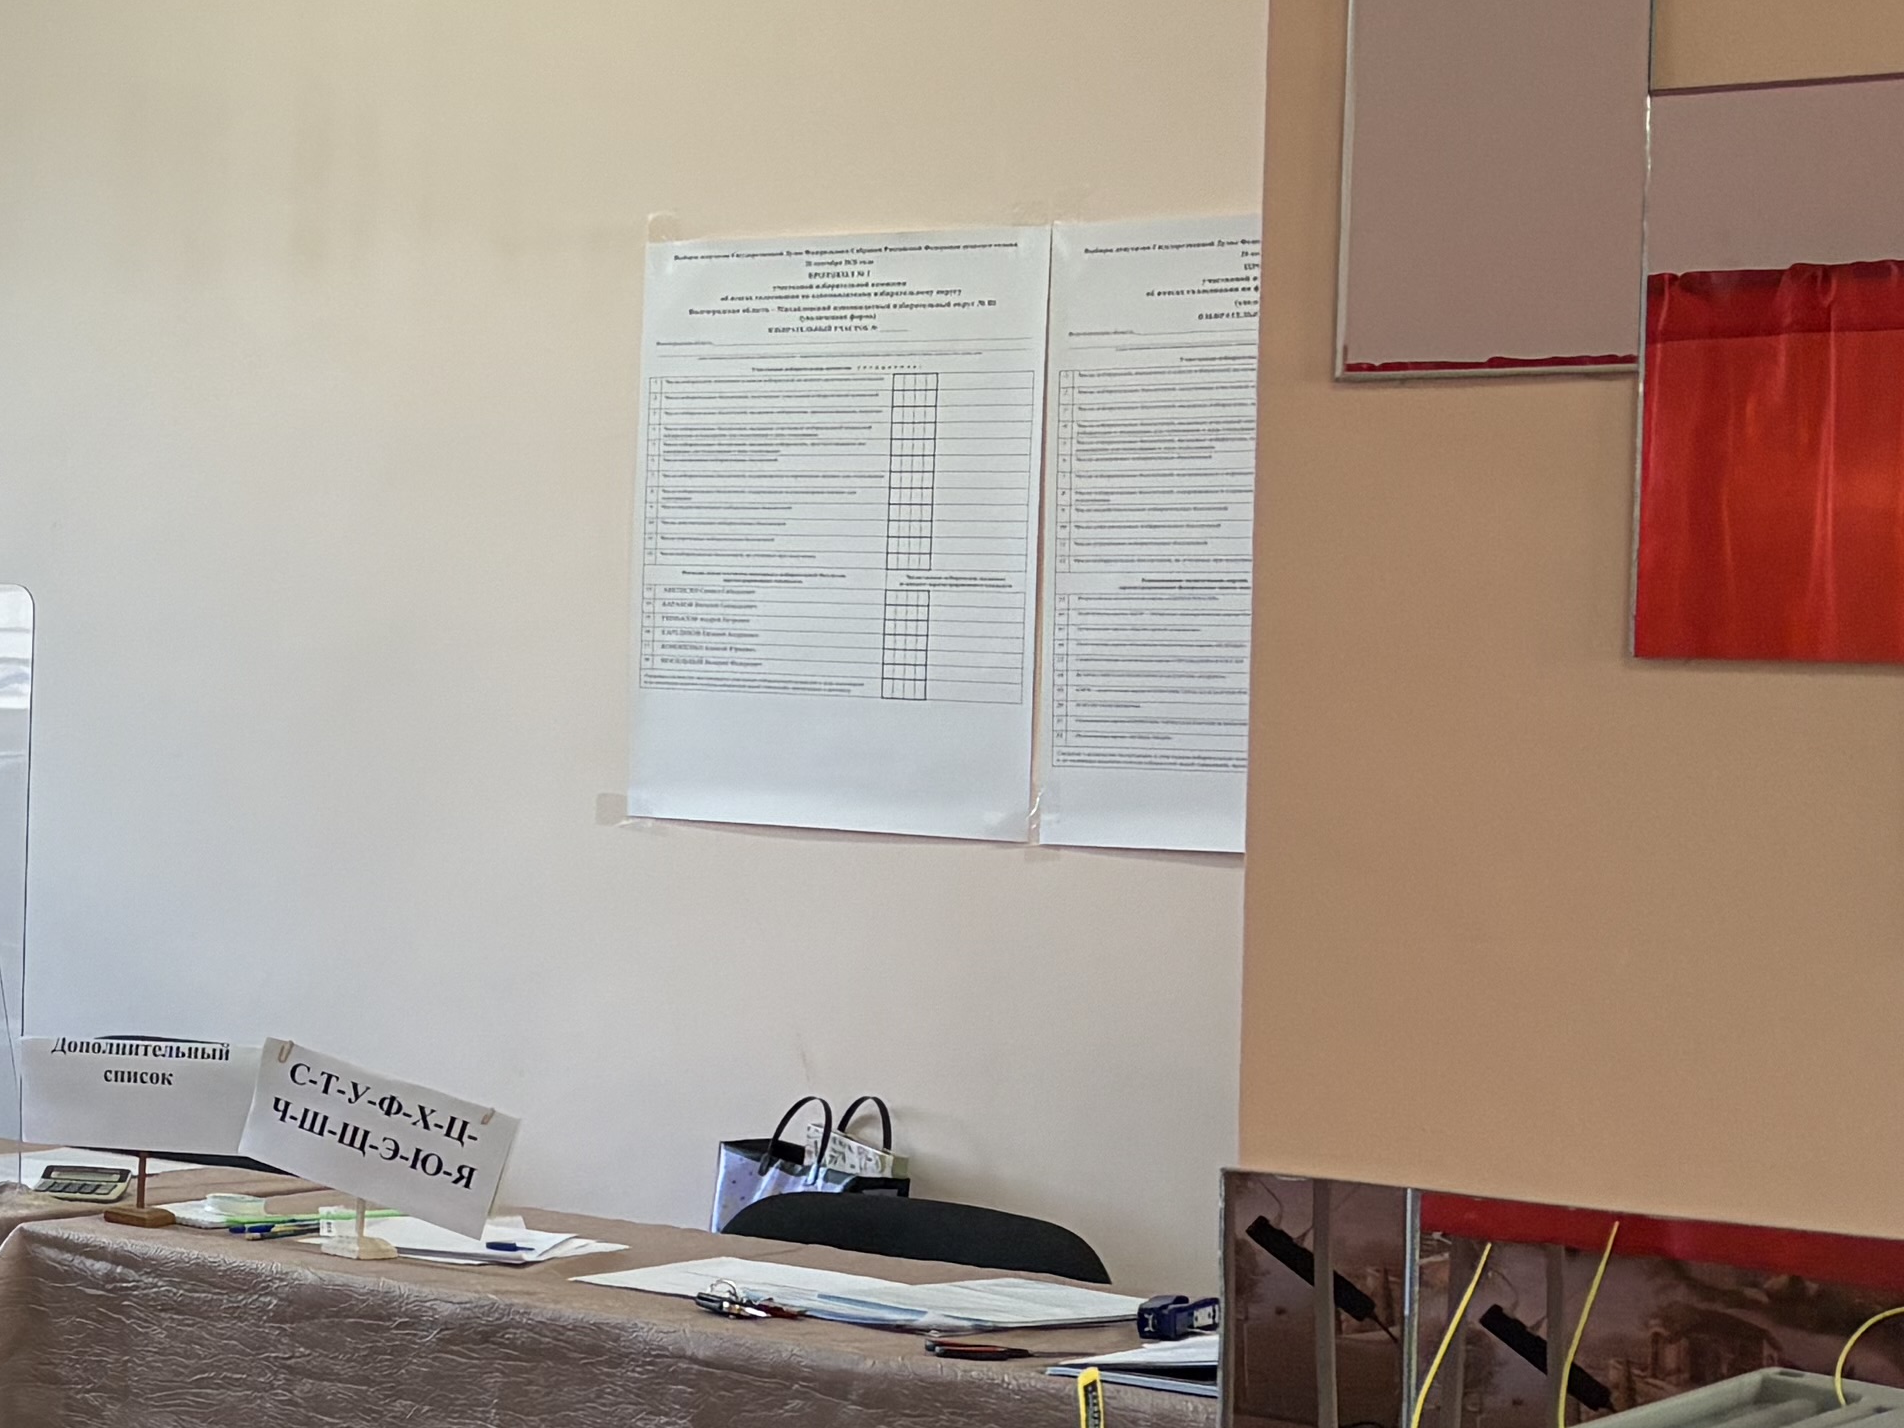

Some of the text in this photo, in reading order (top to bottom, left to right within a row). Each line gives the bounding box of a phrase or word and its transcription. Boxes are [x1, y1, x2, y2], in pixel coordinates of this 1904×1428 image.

[50, 1037, 231, 1061] Дополнительный
[103, 1068, 174, 1086] список
[289, 1062, 478, 1148] С-Т-У-Ф-Х-Ц-
[272, 1096, 478, 1190] Ч-Ш-Щ-Э-Ю-Я
